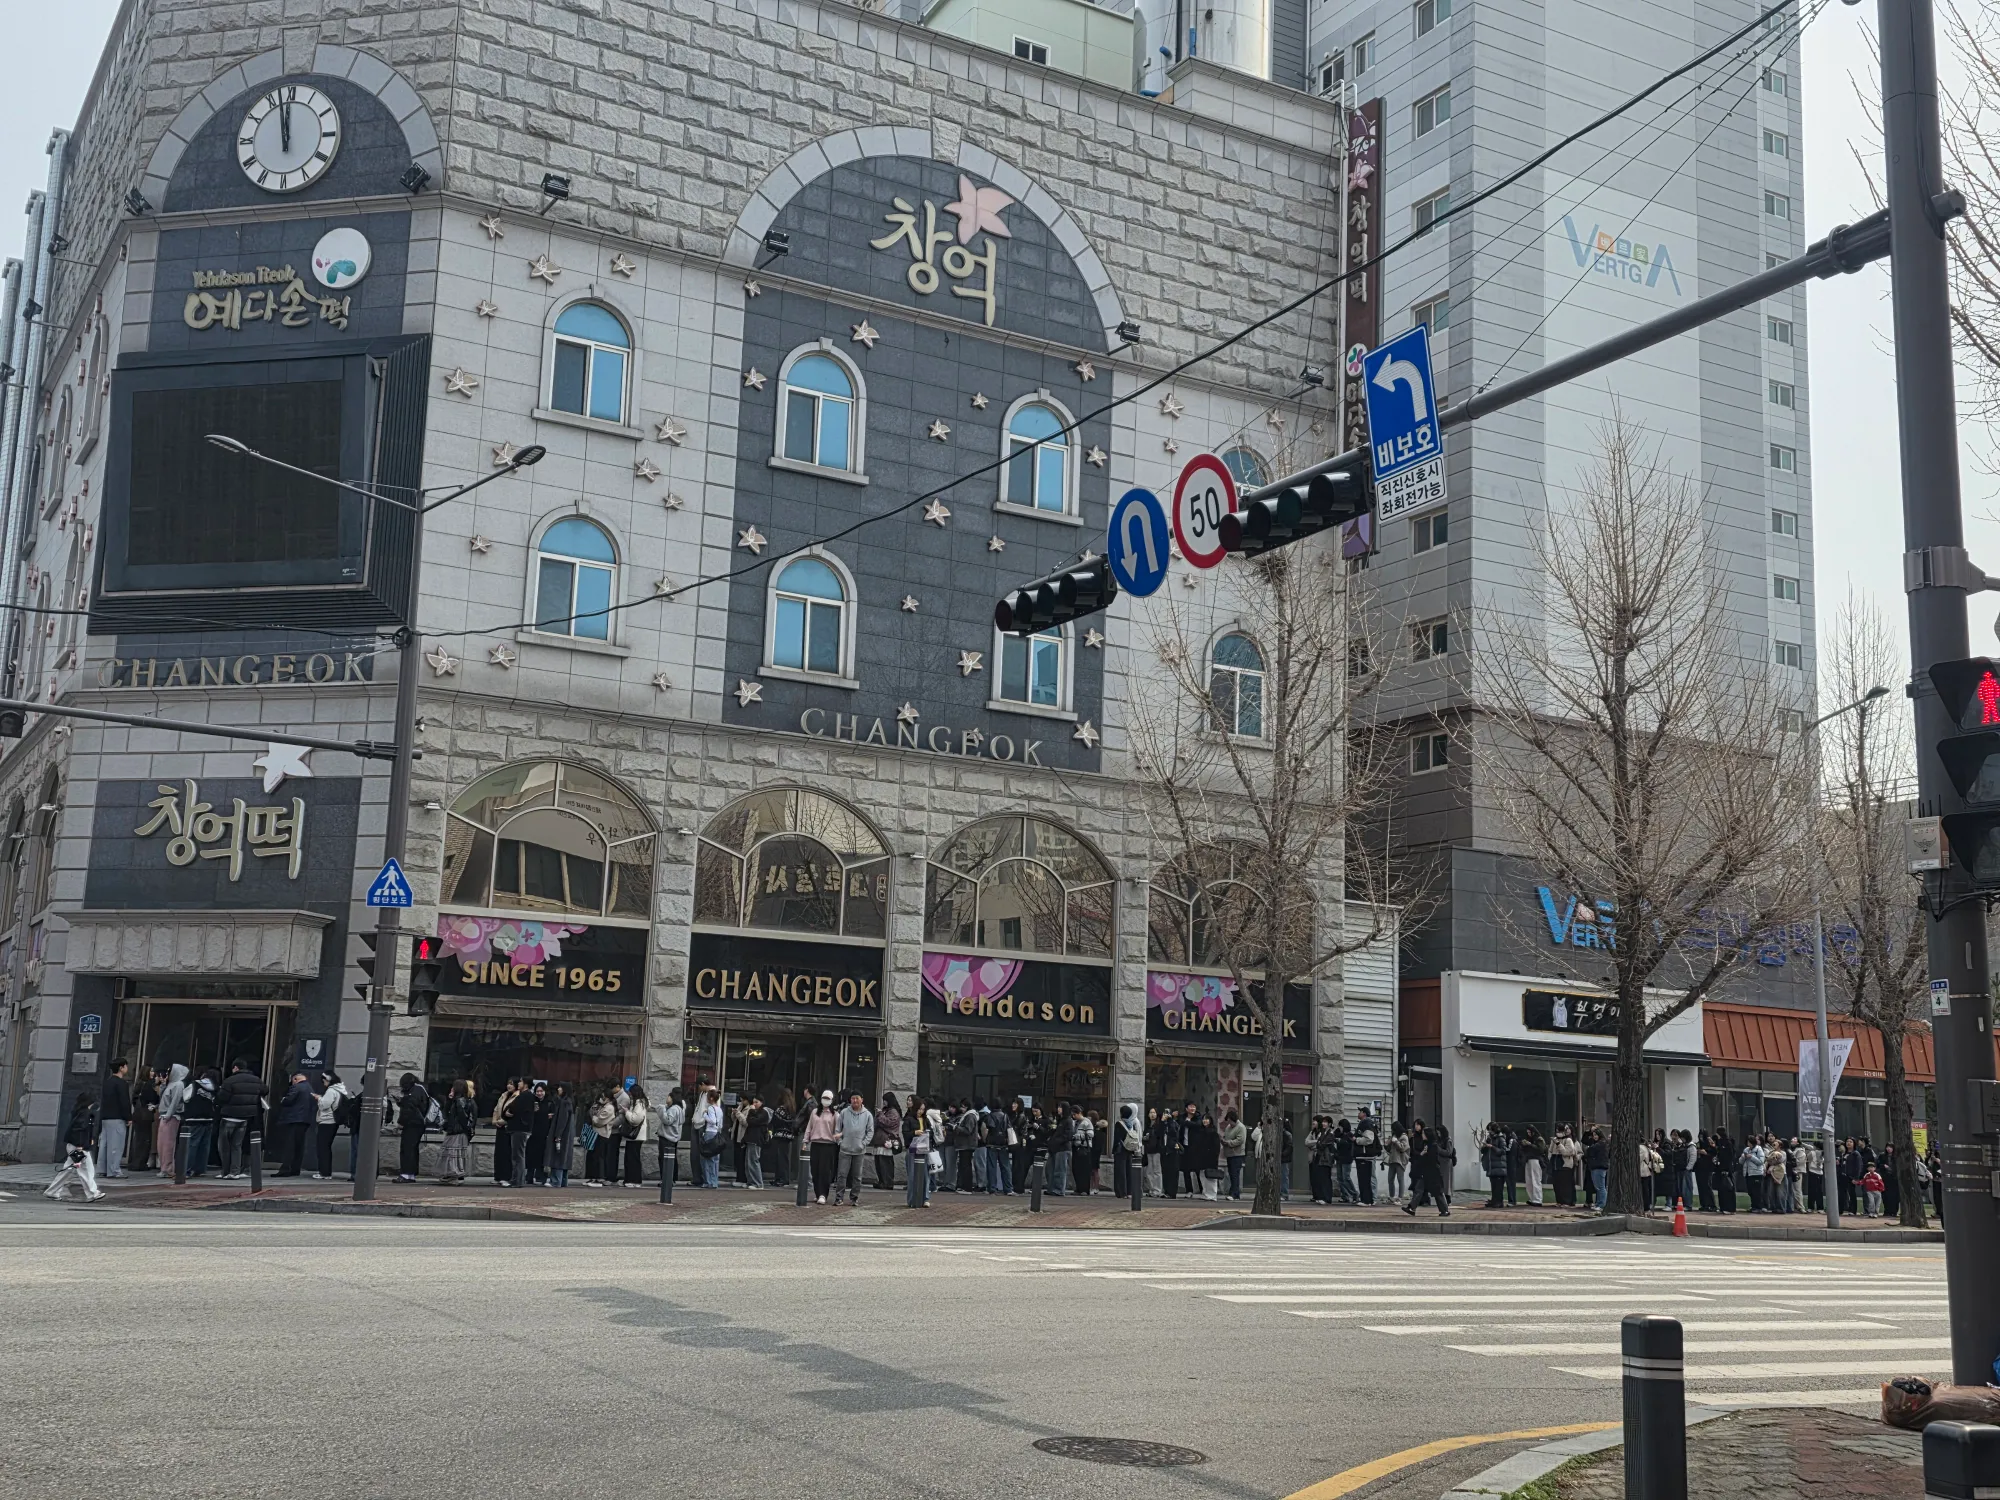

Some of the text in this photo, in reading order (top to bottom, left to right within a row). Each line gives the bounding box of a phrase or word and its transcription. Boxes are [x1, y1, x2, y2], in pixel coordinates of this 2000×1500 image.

[193, 269, 255, 288] Yehdason
[869, 196, 997, 328] 창억
[1377, 423, 1435, 468] 비보호
[1380, 461, 1440, 498] 직진신호시
[1190, 486, 1221, 538] 50
[1381, 482, 1442, 516] 좌회전가능
[97, 651, 368, 689] CHANGEOK
[800, 707, 1043, 767] CHANGEOK
[134, 778, 305, 882] 창억떡
[461, 960, 622, 993] SINCE 1965
[695, 967, 878, 1009] CHANGEOK
[943, 990, 1094, 1024] Yehdason
[1163, 1009, 1297, 1039] CHANGEK
[82, 1022, 98, 1032] 242
